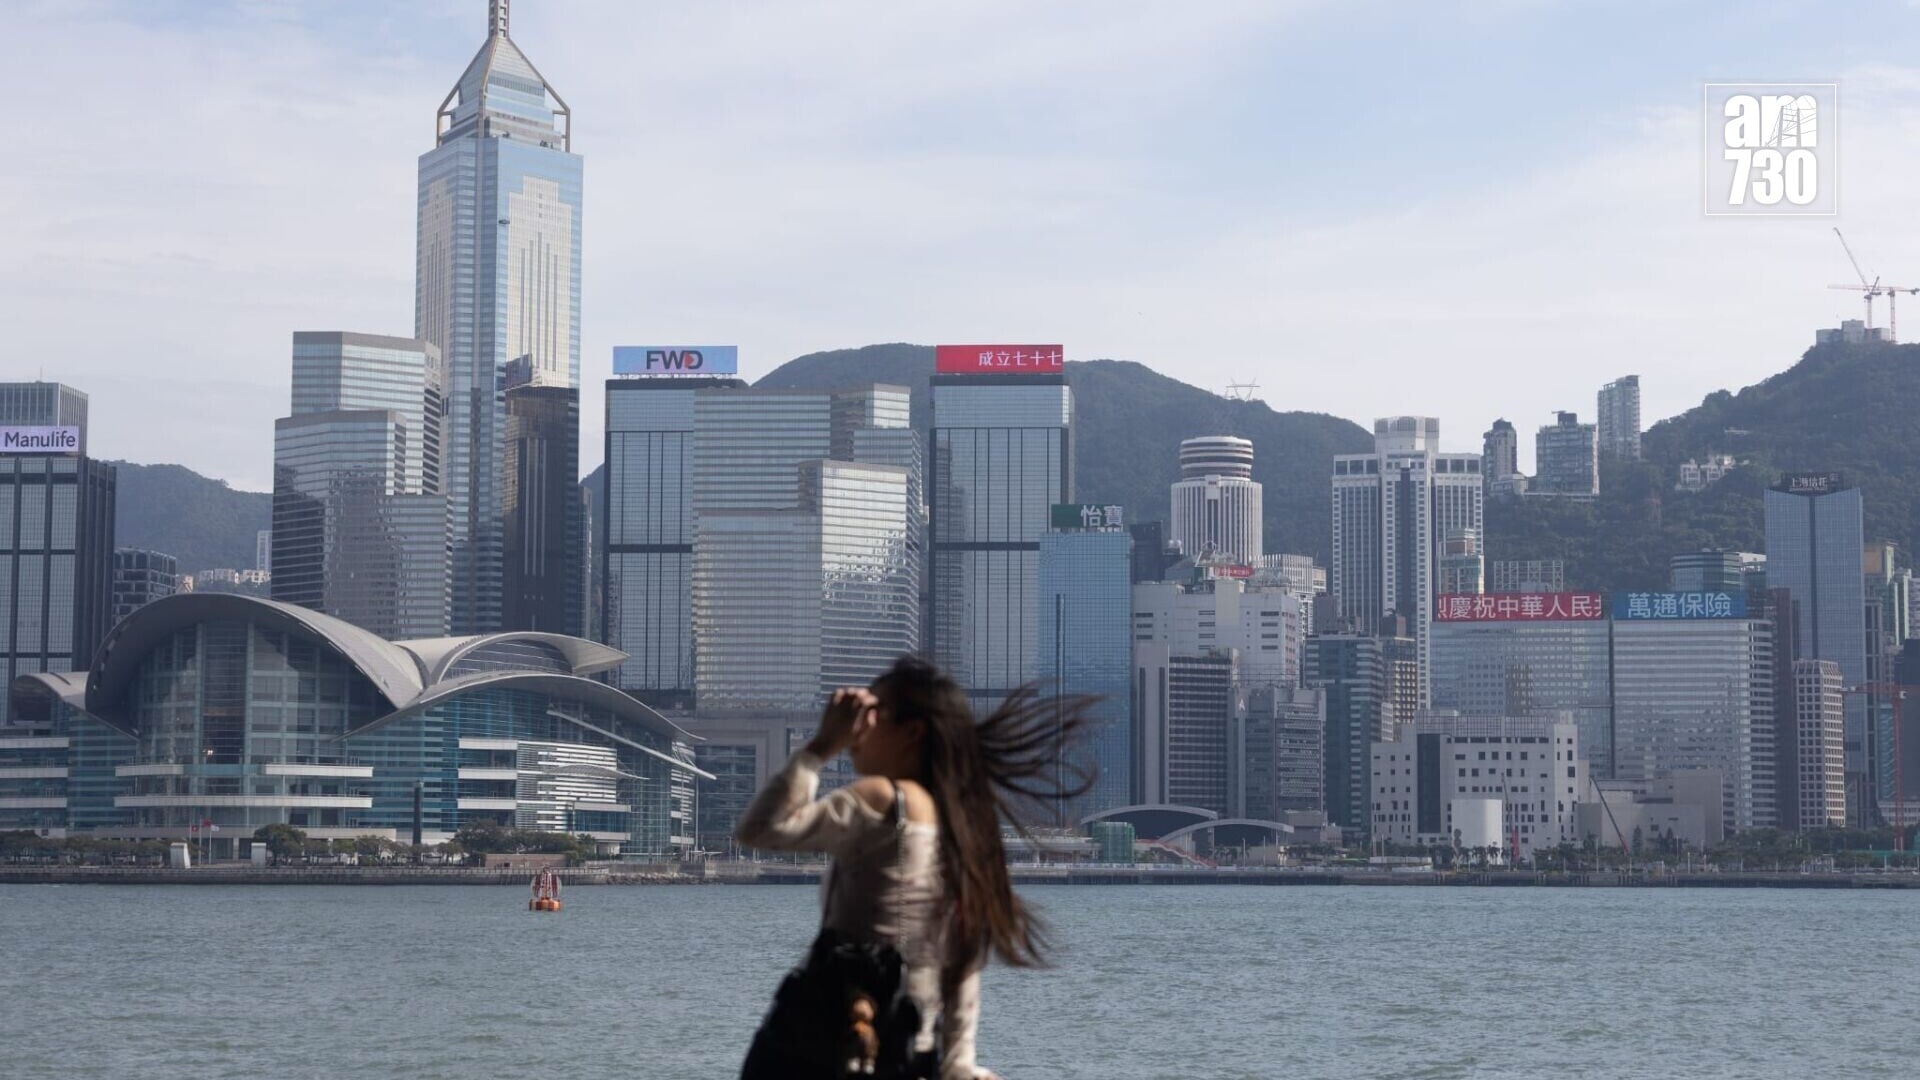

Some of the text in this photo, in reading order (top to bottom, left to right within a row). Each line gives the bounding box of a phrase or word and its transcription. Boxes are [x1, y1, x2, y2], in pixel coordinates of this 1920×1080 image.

[646, 350, 703, 370] FWD
[979, 351, 1062, 366] 成立七十七
[4, 430, 76, 447] Manulife
[1080, 504, 1123, 527] 怡寶
[1627, 592, 1732, 618] 萬通保險
